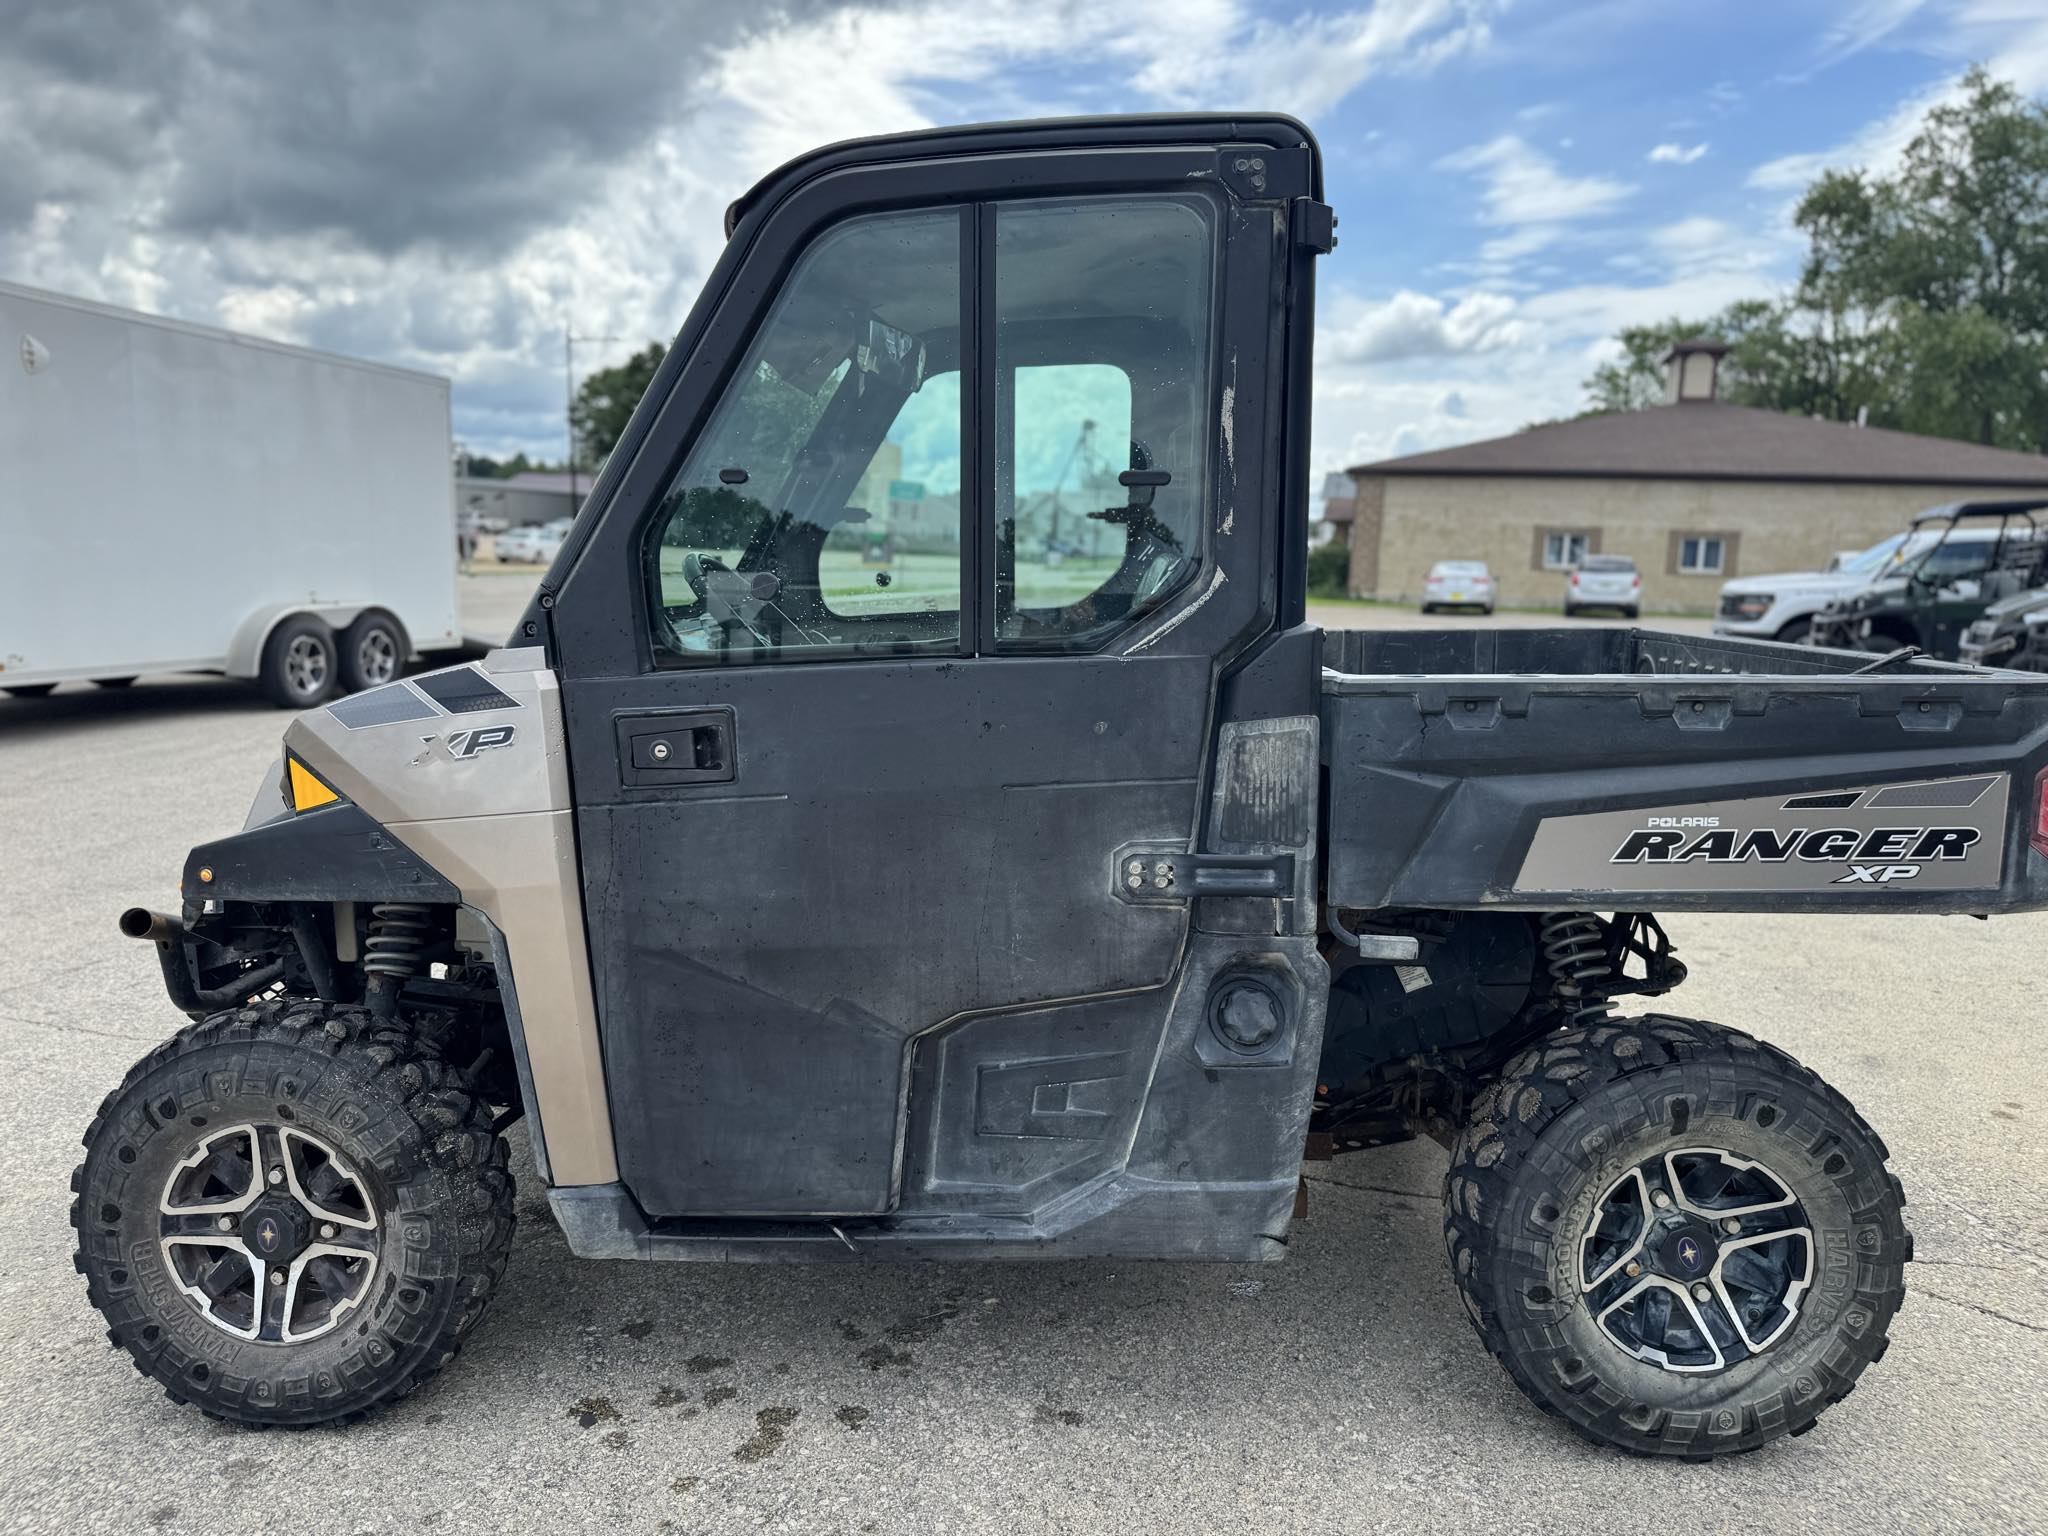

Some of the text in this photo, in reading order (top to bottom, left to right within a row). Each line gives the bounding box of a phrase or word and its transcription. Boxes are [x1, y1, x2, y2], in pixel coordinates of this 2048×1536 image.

[1647, 816, 1721, 829] POLARIS
[1609, 827, 1983, 863] RANGER
[1828, 864, 1922, 885] XP
[130, 1238, 244, 1365] HARVESTER
[1769, 1228, 1851, 1377] HARVESTER
